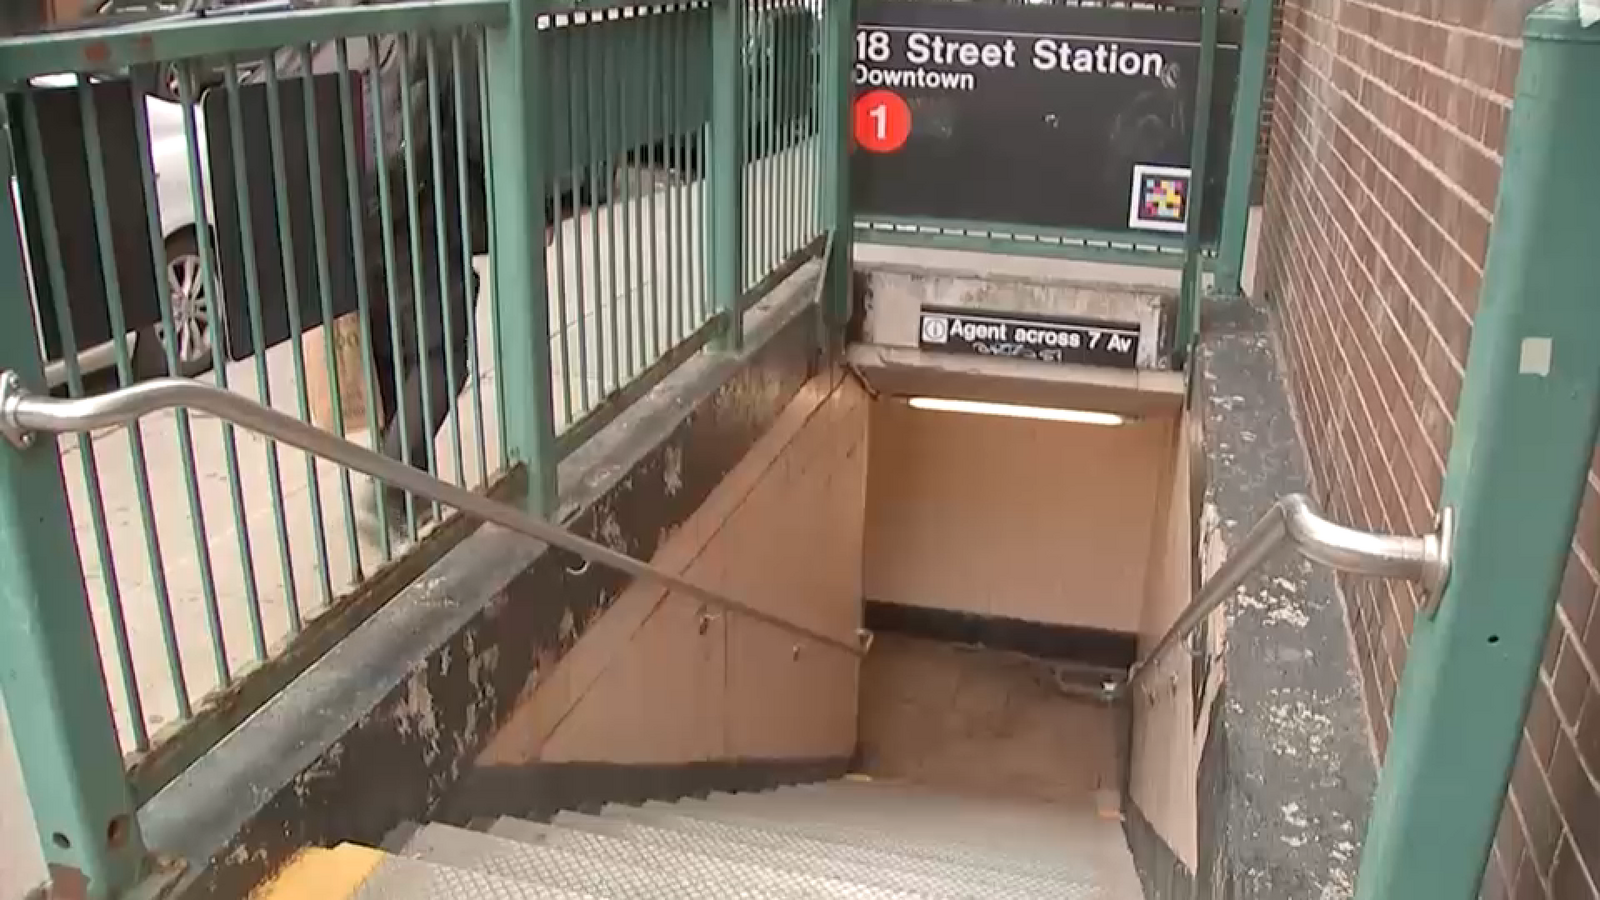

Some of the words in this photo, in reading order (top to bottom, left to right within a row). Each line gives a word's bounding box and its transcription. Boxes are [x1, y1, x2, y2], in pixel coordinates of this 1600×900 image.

[856, 31, 890, 61] 18
[906, 33, 1016, 67] Street
[1033, 39, 1164, 77] Station
[855, 63, 974, 90] Downtown
[869, 104, 887, 140] 1
[950, 318, 1007, 341] Agent
[1014, 328, 1080, 347] across
[1088, 331, 1102, 349] 7
[1107, 334, 1132, 352] Av
